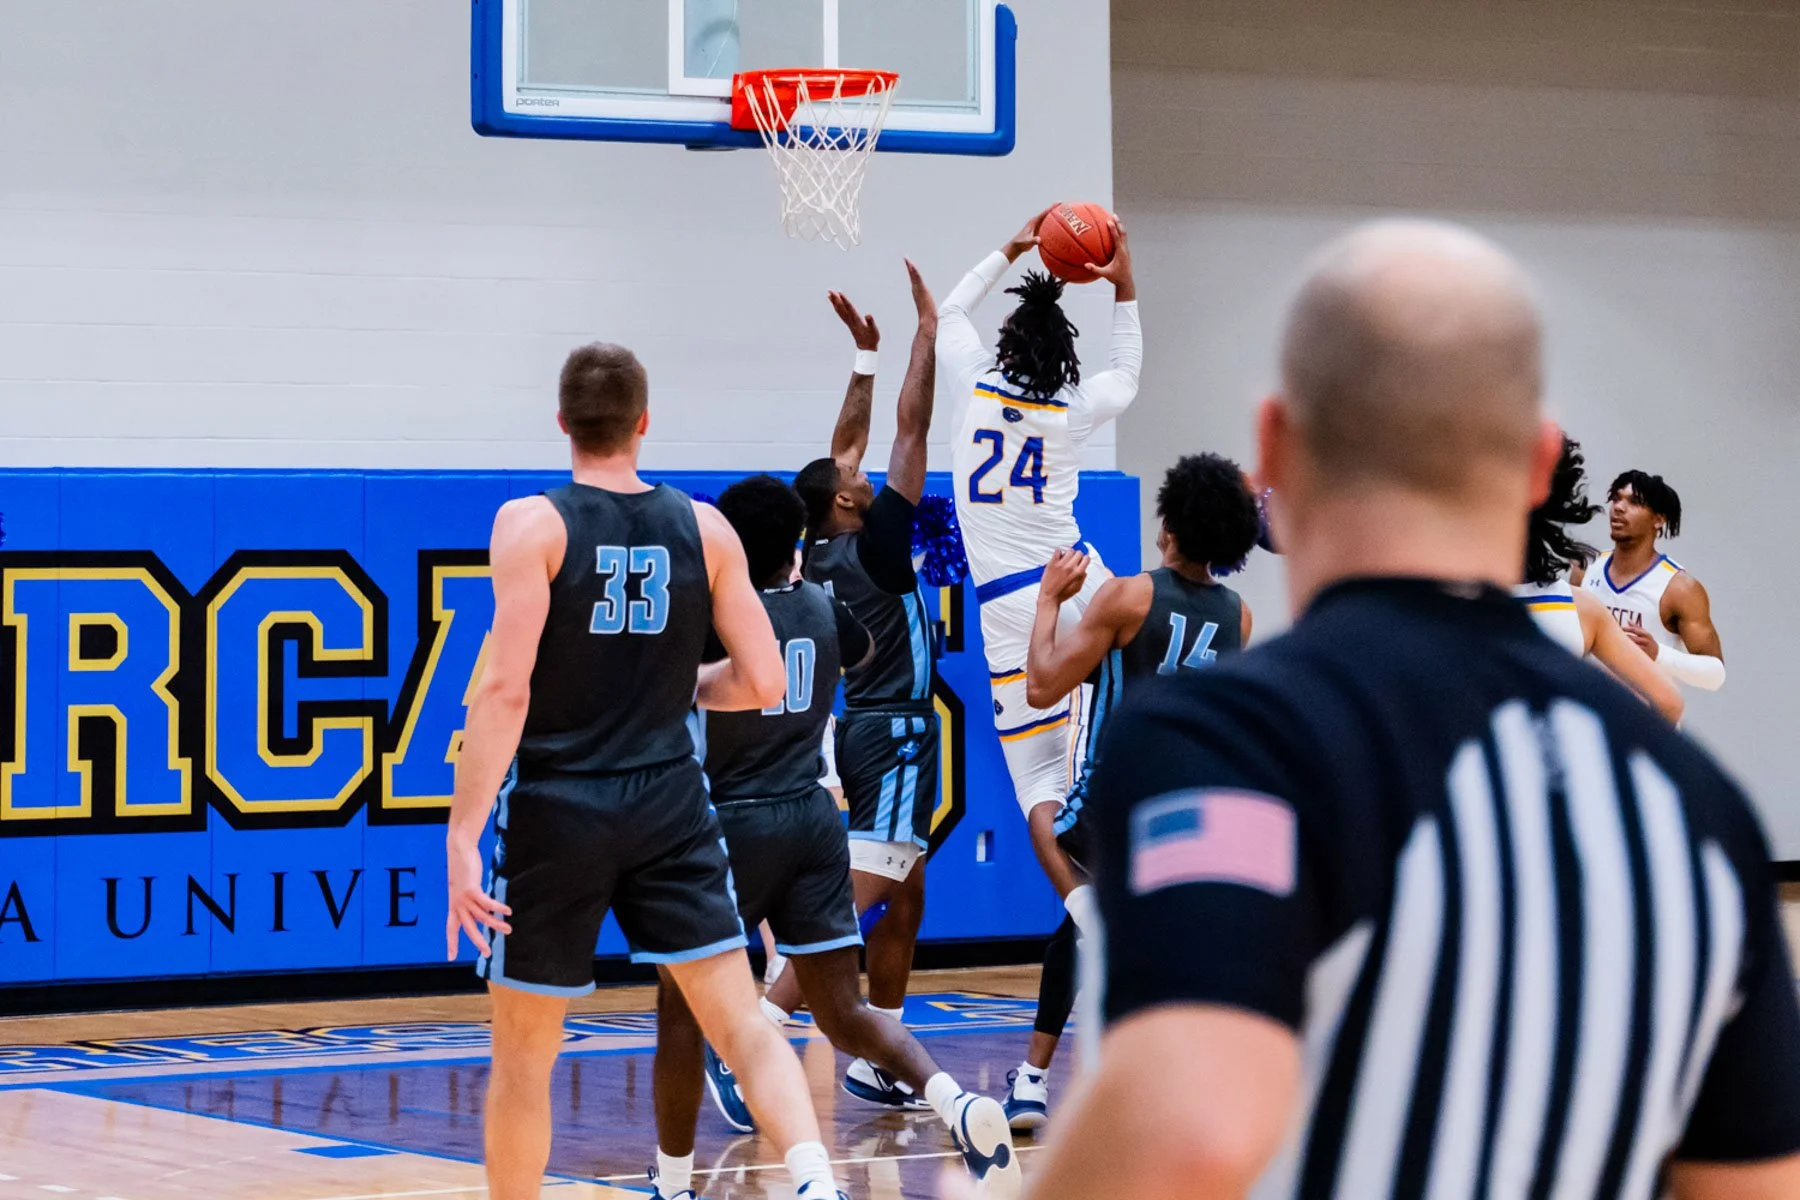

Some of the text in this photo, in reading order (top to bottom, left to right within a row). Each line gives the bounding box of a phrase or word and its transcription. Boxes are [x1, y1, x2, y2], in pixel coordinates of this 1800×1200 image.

[968, 428, 1049, 505] 24
[589, 545, 670, 634] 33
[1156, 611, 1219, 676] 14
